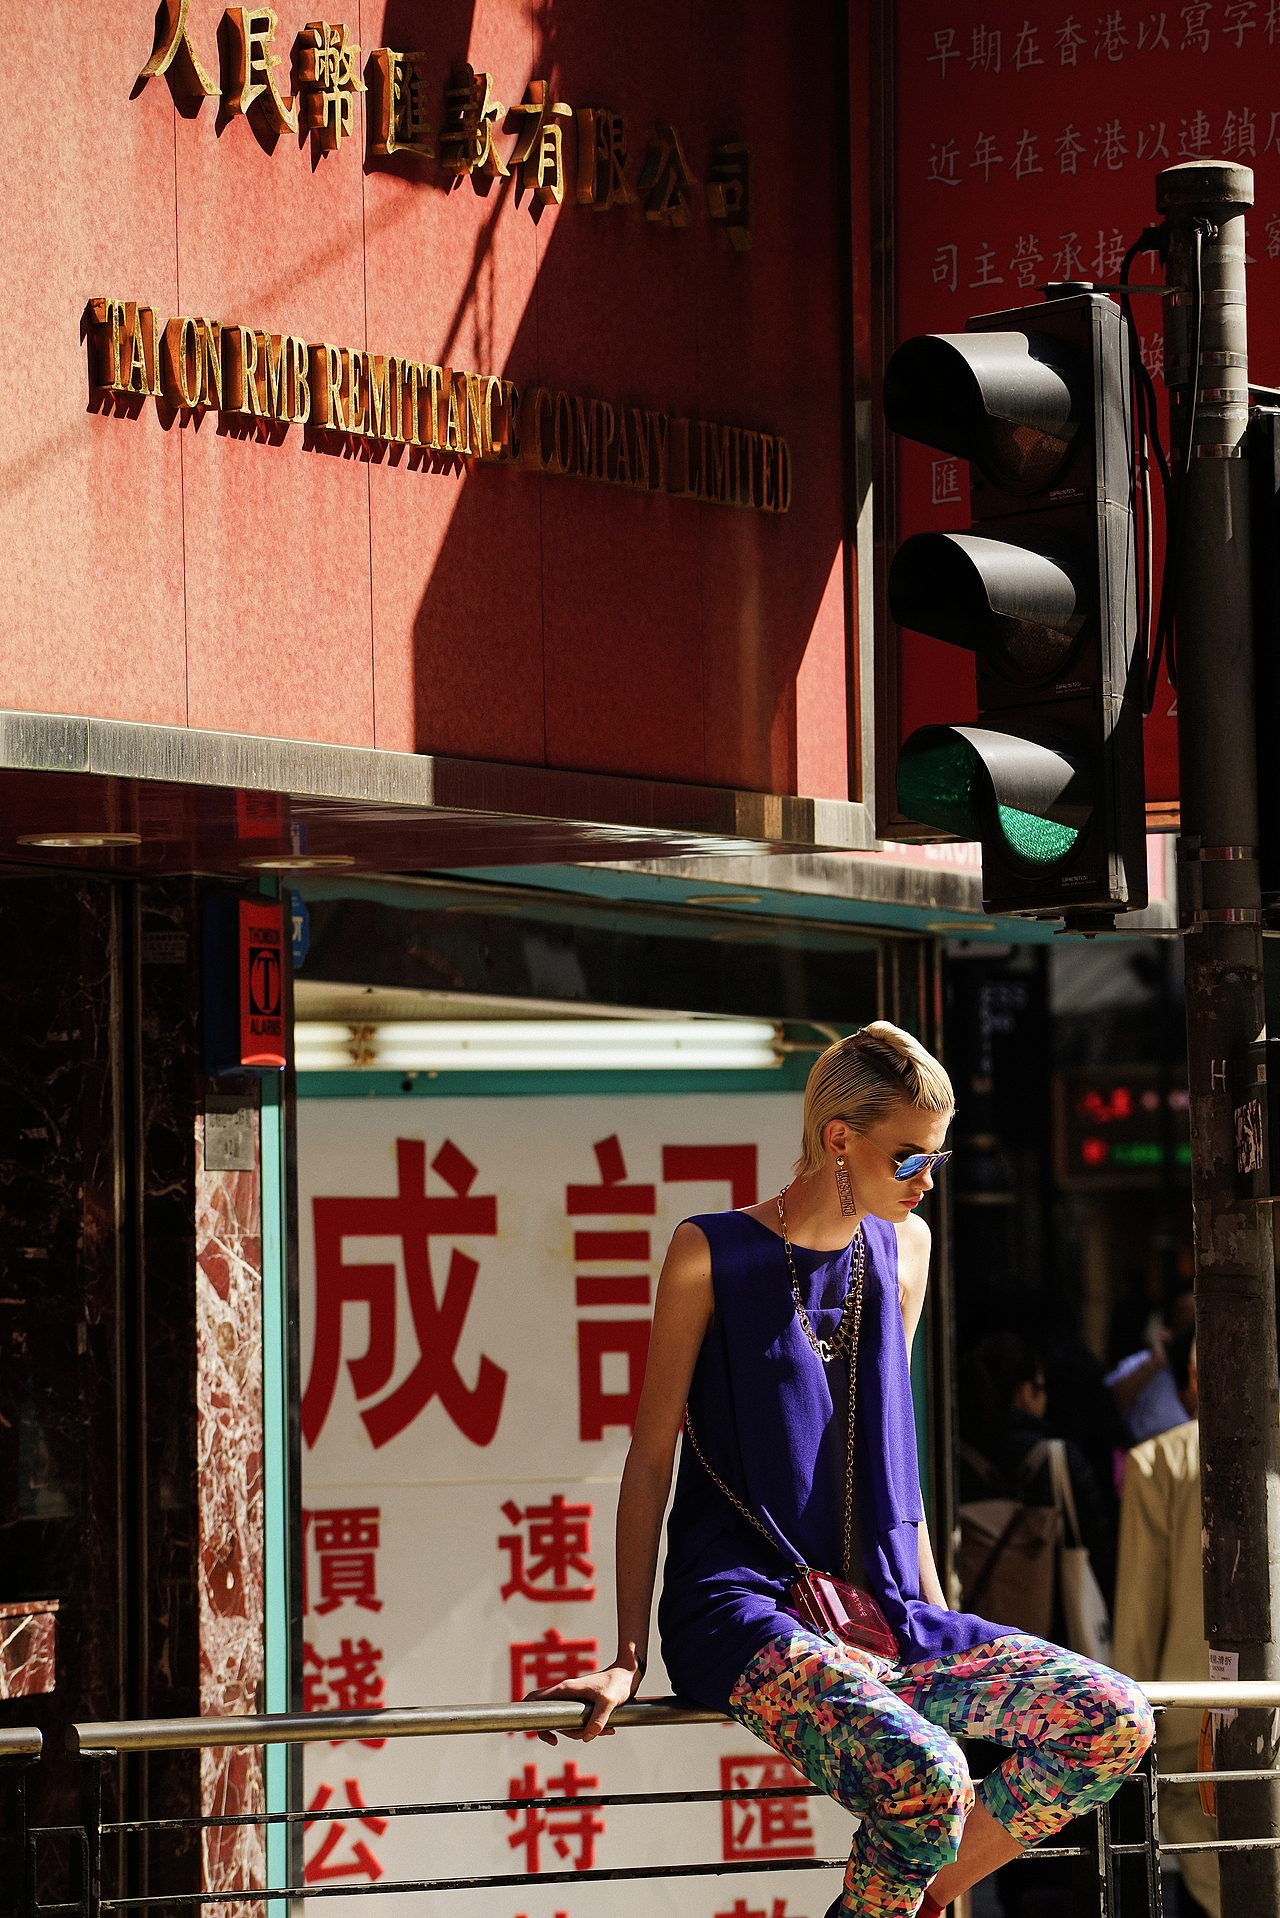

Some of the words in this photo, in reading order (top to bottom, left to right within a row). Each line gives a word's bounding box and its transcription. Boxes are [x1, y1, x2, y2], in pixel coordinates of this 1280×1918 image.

[139, 0, 754, 252] 人民幣匯款有限公司
[89, 298, 163, 397] TAI
[166, 316, 225, 410] ON
[228, 325, 312, 425] RMB
[311, 342, 520, 463] REMITTANCE
[524, 386, 669, 491] COMPANY
[670, 416, 791, 513] LIMITED
[931, 456, 963, 506] 匯
[249, 927, 281, 945] THOMSON
[257, 957, 275, 1011] T
[250, 1019, 282, 1037] ALARMS
[497, 1495, 606, 1918] 速度特
